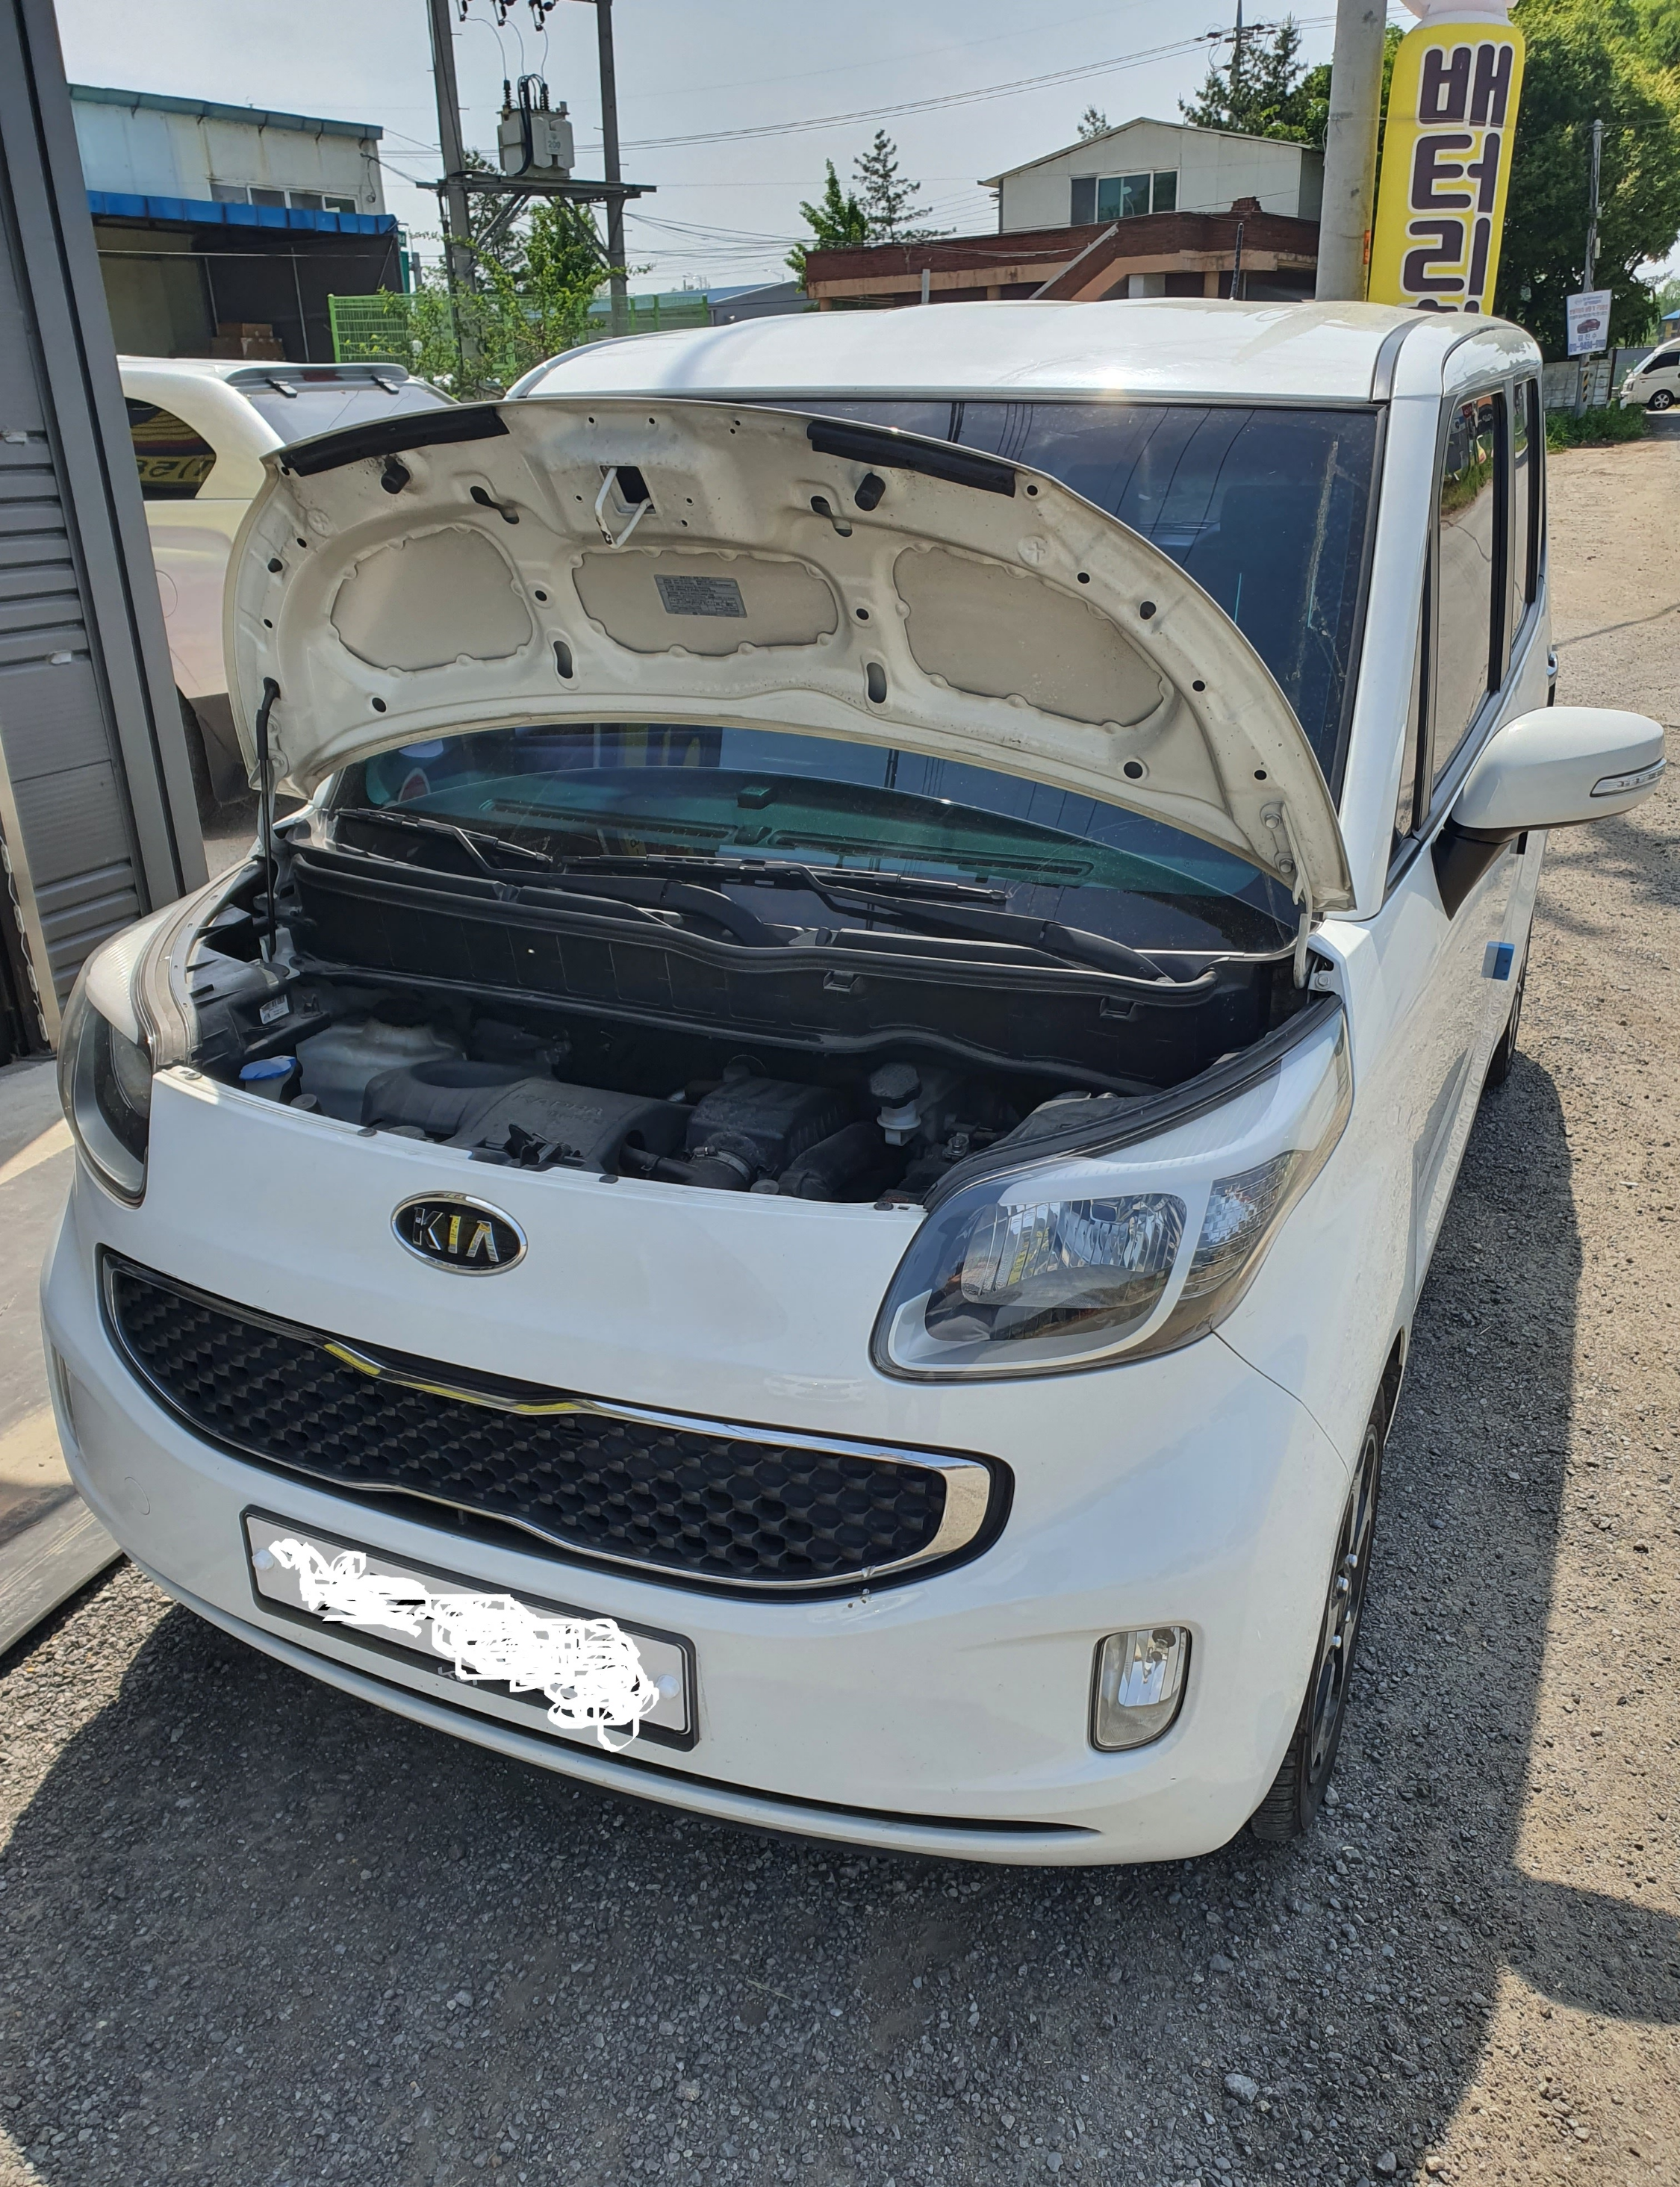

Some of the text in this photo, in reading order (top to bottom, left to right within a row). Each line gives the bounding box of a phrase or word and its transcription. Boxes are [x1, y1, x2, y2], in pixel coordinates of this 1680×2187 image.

[547, 140, 561, 149] 200
[1404, 43, 1513, 313] 배터리
[412, 1207, 500, 1262] KIA
